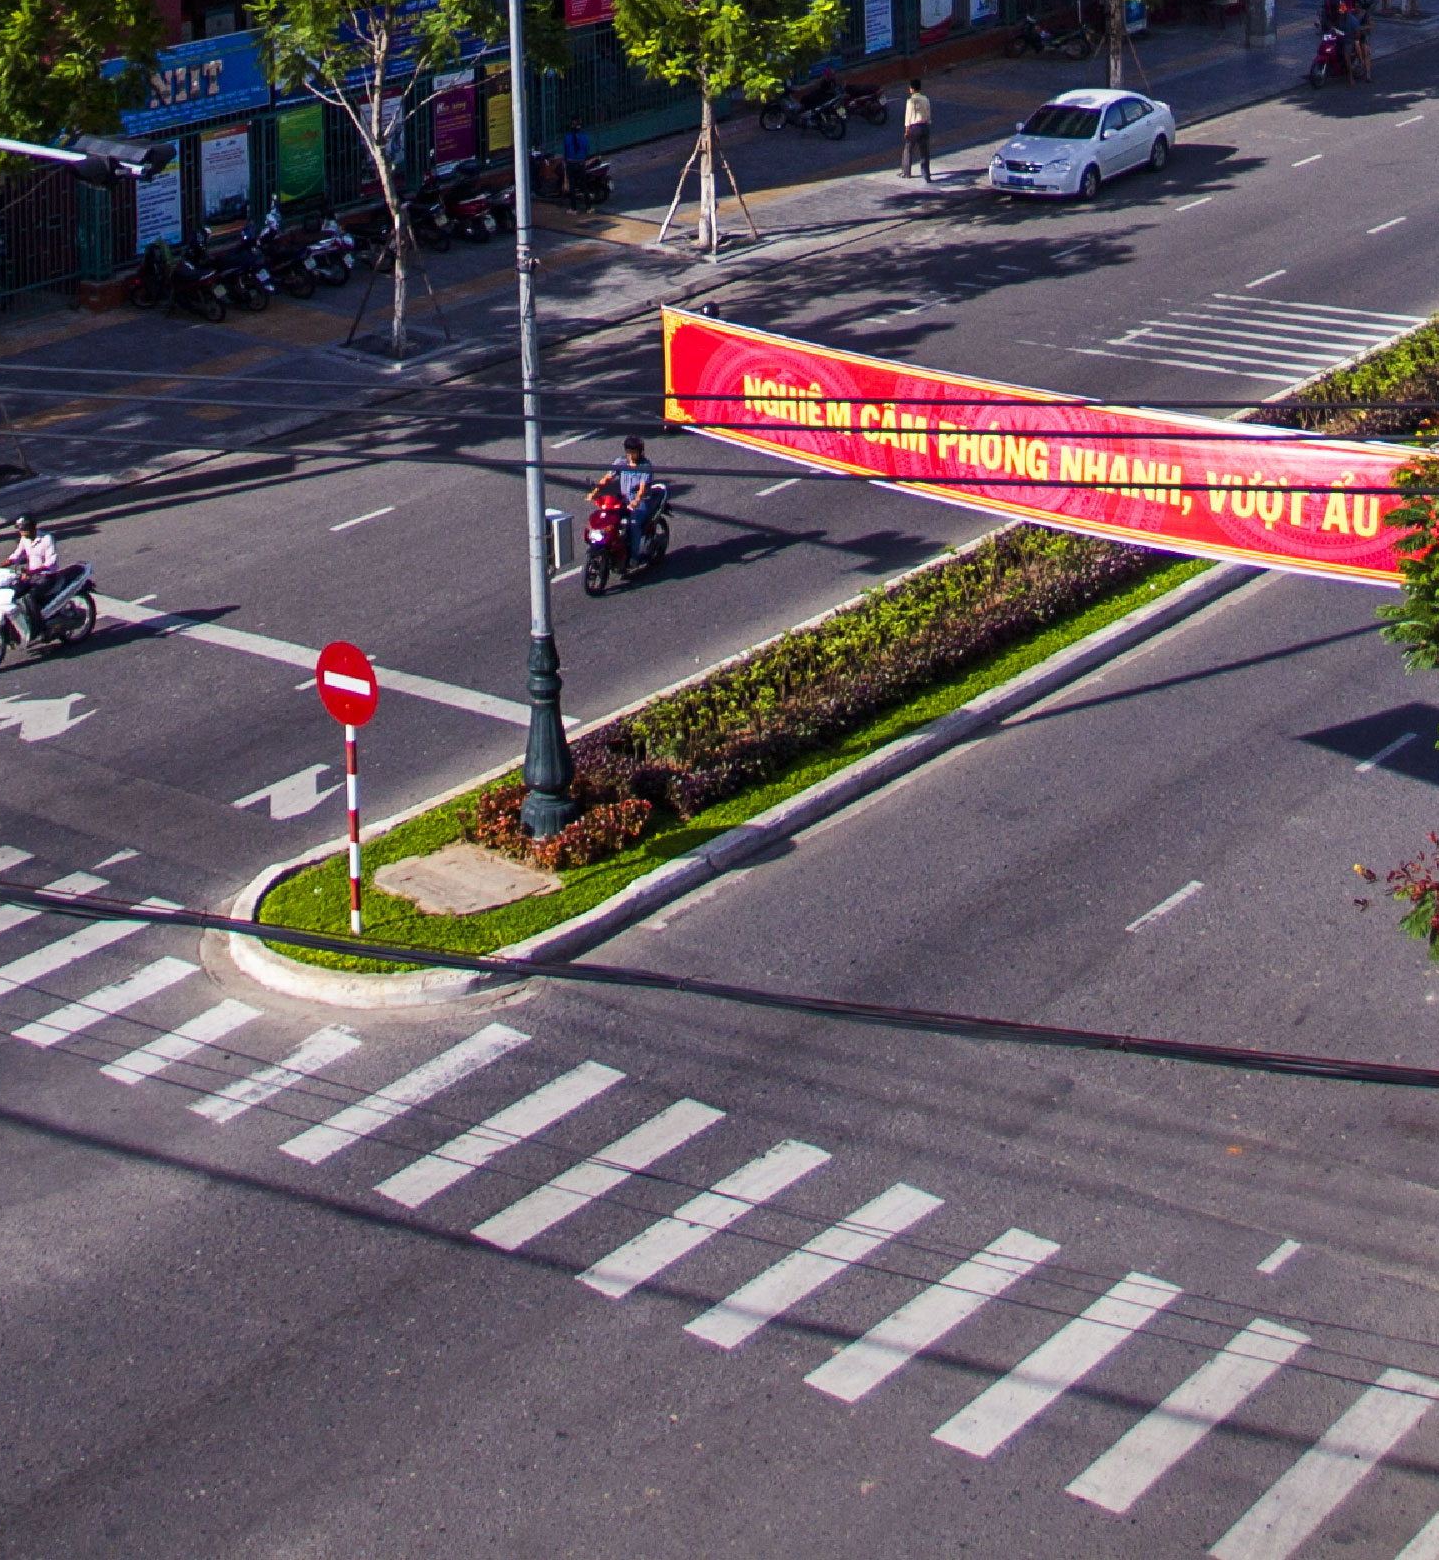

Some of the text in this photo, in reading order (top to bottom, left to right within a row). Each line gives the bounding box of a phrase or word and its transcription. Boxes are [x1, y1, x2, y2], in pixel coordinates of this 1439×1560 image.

[150, 59, 223, 110] NIIT
[742, 374, 852, 436] NGHIÊM
[937, 420, 1049, 482] PHÓNG
[1059, 443, 1194, 516] NHANH,
